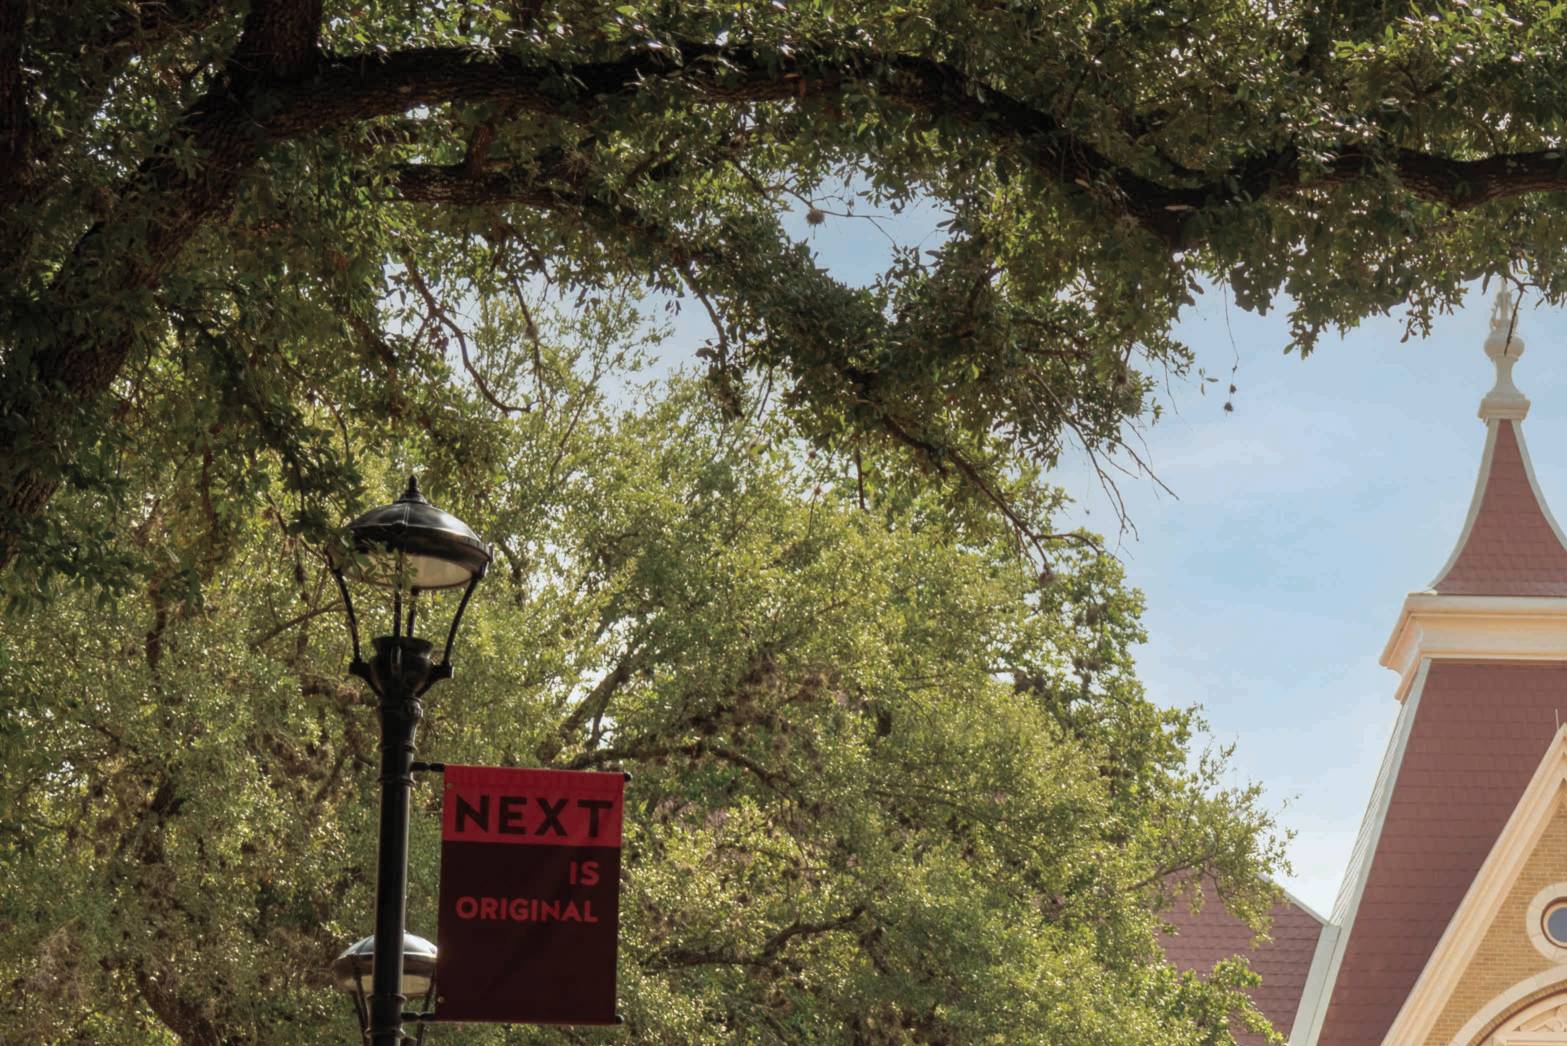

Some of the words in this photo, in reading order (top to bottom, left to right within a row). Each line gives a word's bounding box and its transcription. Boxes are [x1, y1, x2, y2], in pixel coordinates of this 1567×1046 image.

[454, 794, 613, 837] NEXT
[569, 861, 599, 885] IS
[456, 897, 598, 922] ORIGINAL
